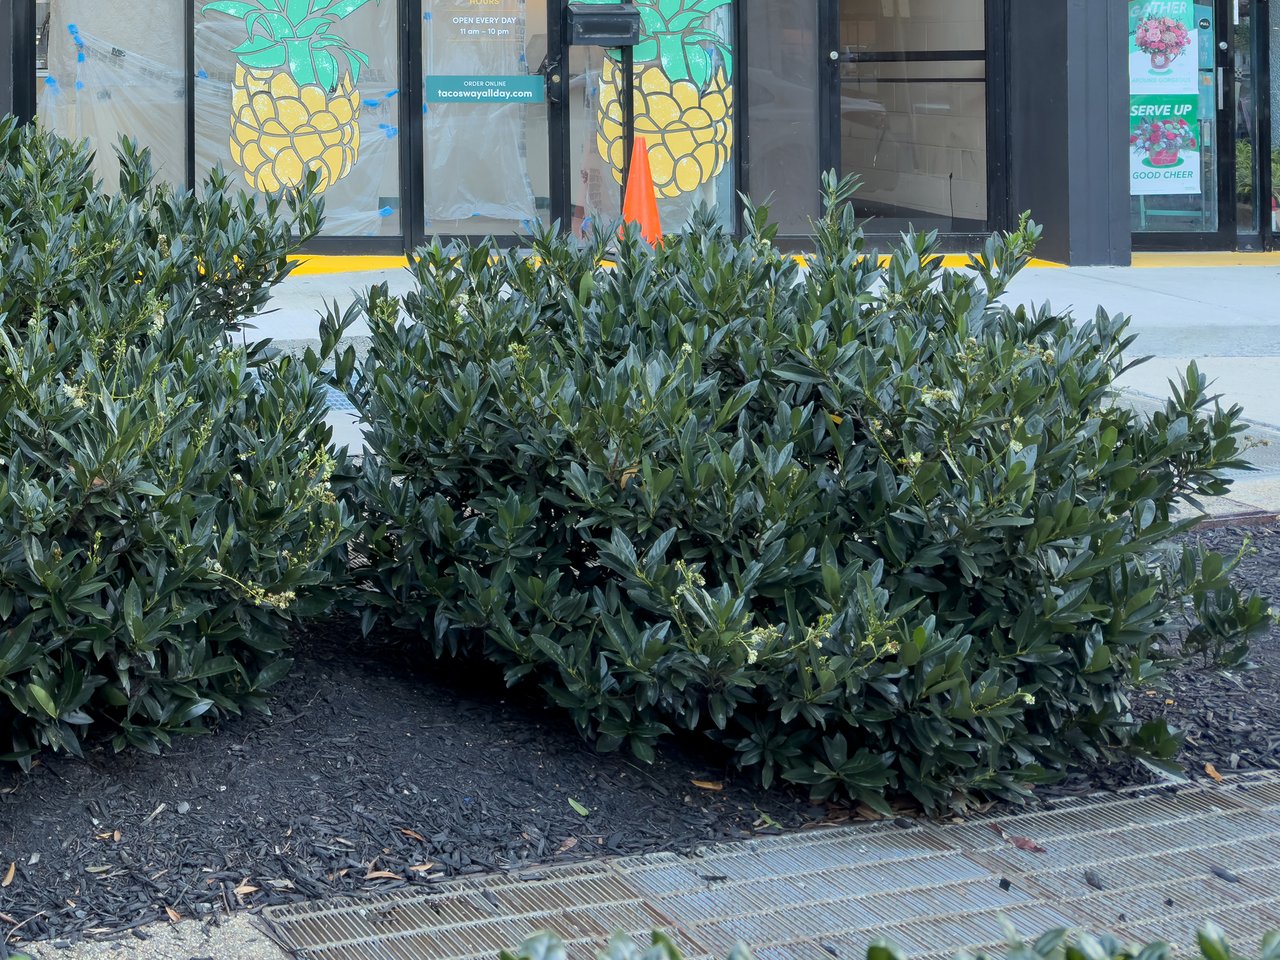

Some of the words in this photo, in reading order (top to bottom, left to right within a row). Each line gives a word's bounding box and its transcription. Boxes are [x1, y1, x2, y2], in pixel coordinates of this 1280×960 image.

[1130, 1, 1187, 17] GATHER
[437, 88, 533, 100] tacoswayallday.com
[1130, 105, 1172, 117] SERVE
[1173, 104, 1192, 116] UP
[1132, 171, 1162, 180] GOOD
[1163, 170, 1194, 179] CHEER
